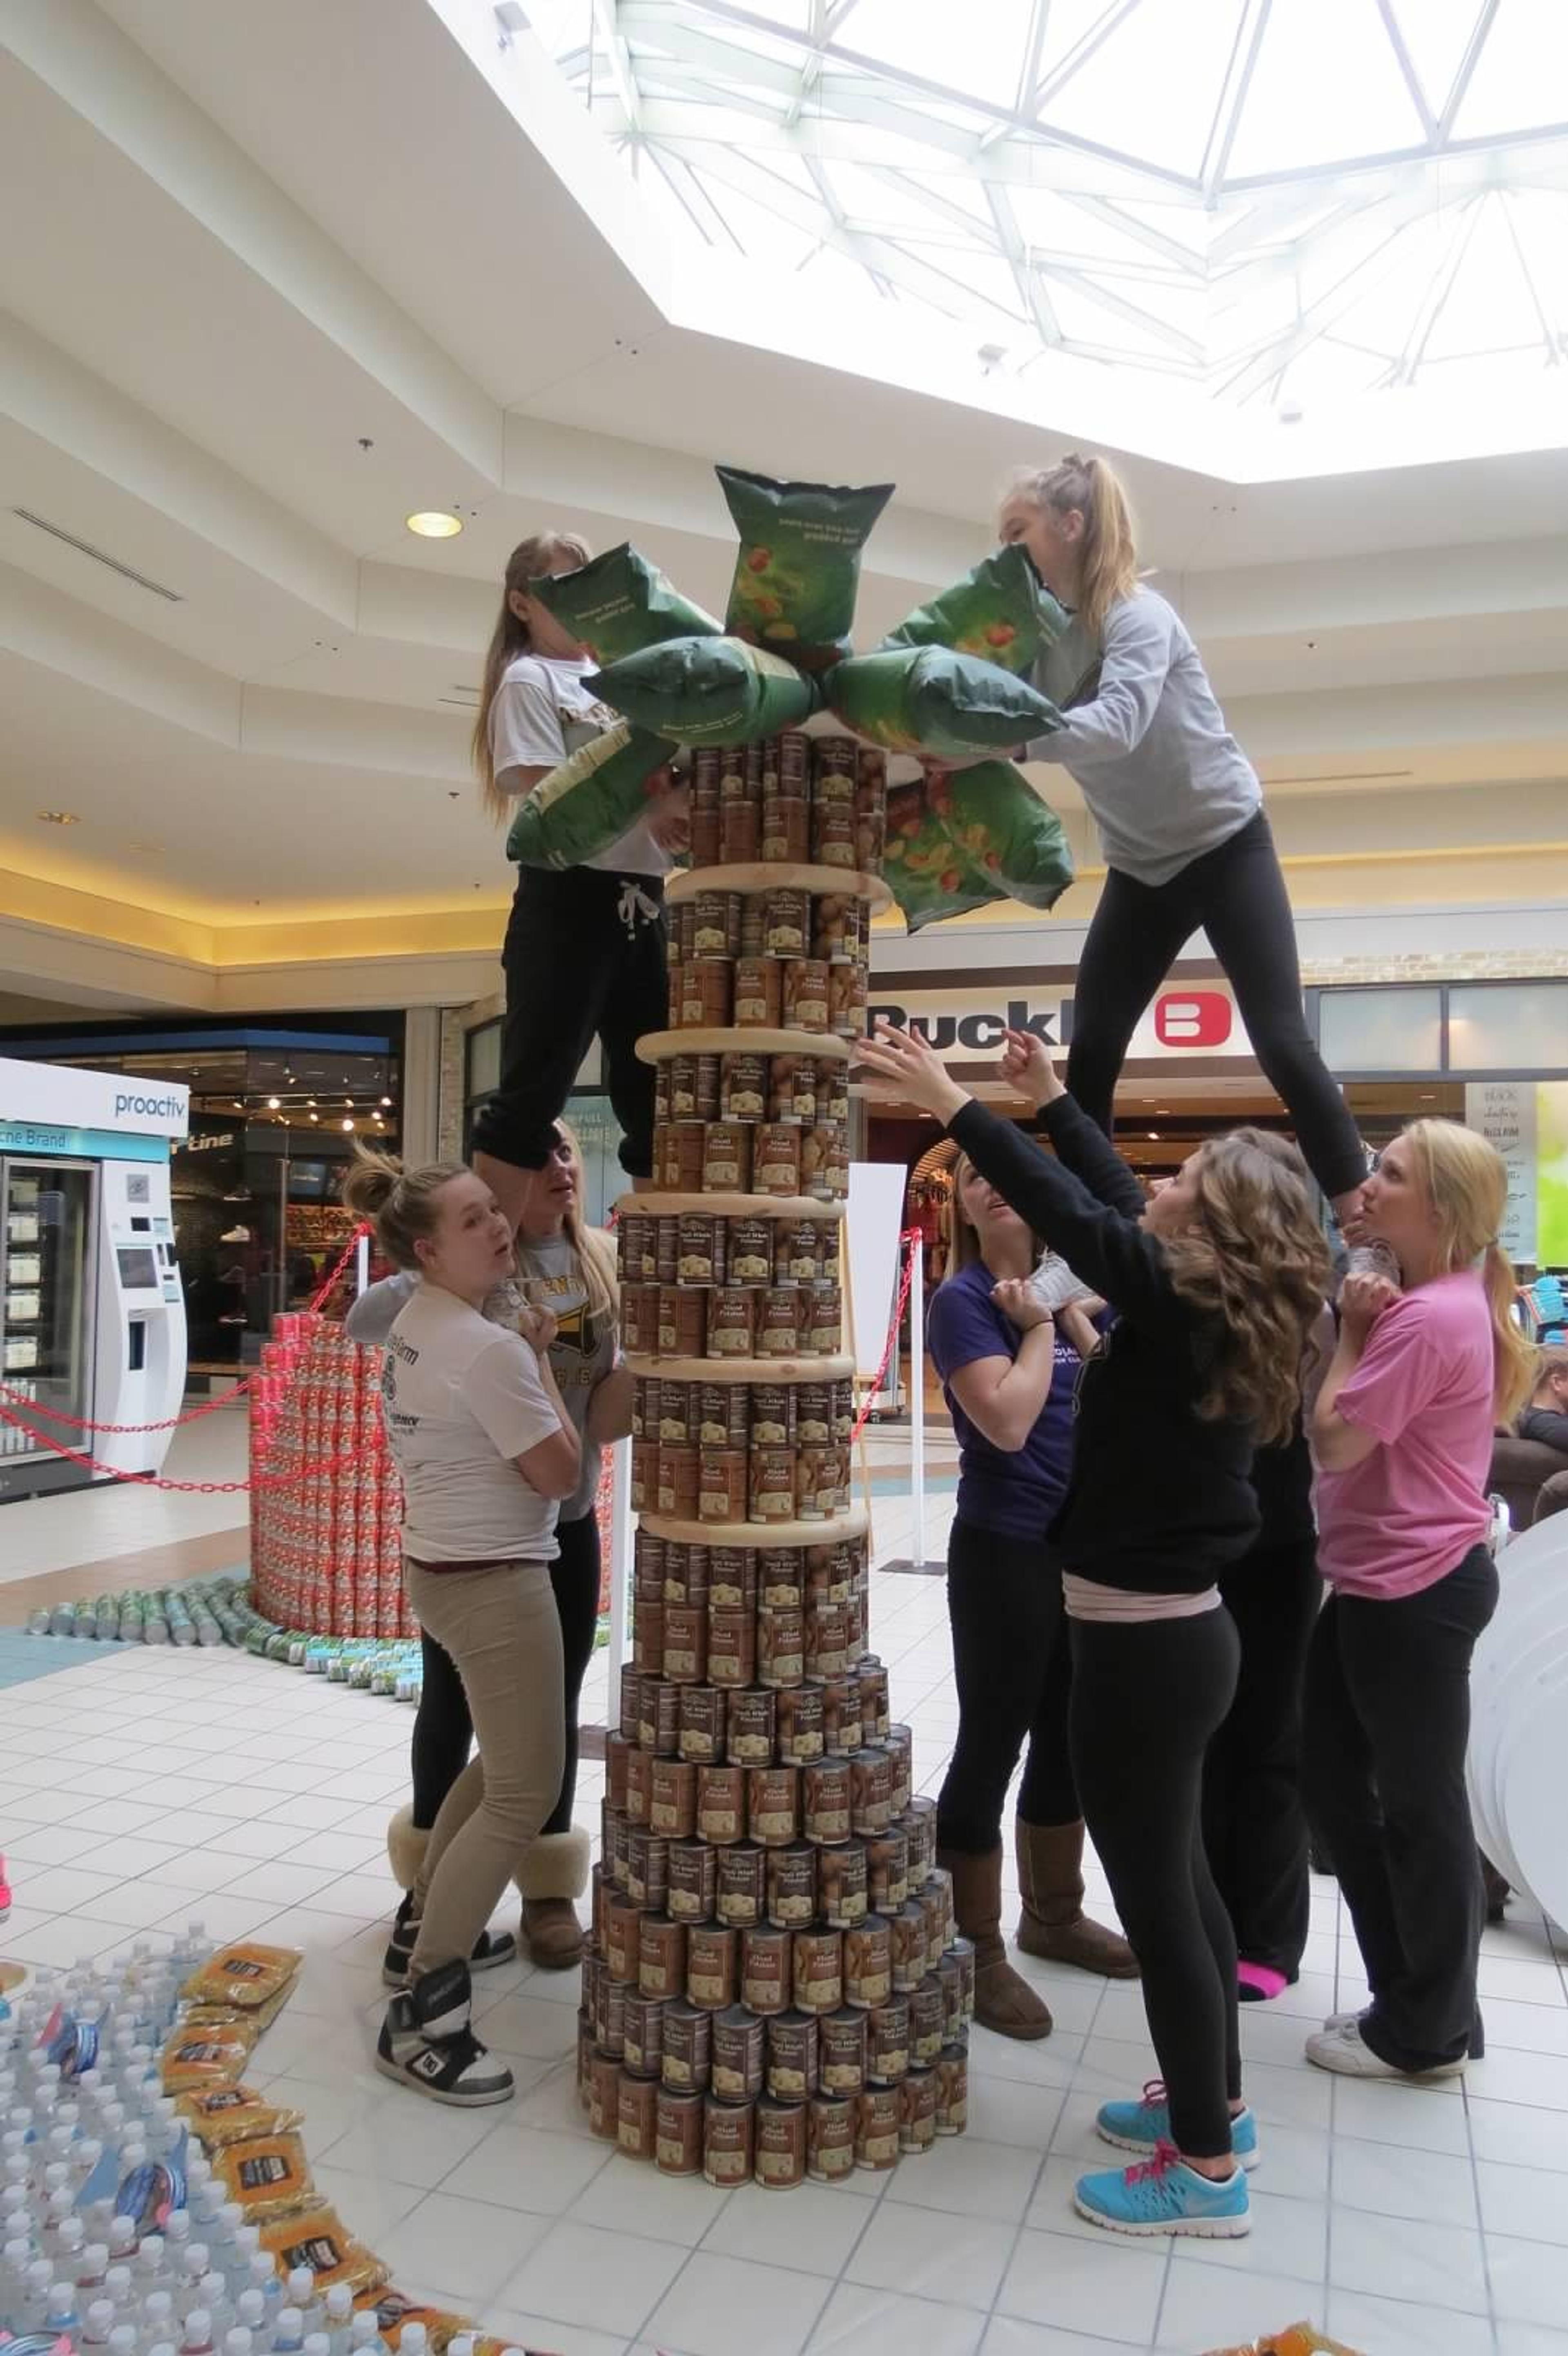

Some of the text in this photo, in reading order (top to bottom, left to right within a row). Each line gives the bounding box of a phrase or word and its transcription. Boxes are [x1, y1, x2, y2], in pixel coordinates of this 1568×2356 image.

[867, 1000, 1076, 1049] Buckl
[0, 1129, 66, 1148] cne Brand
